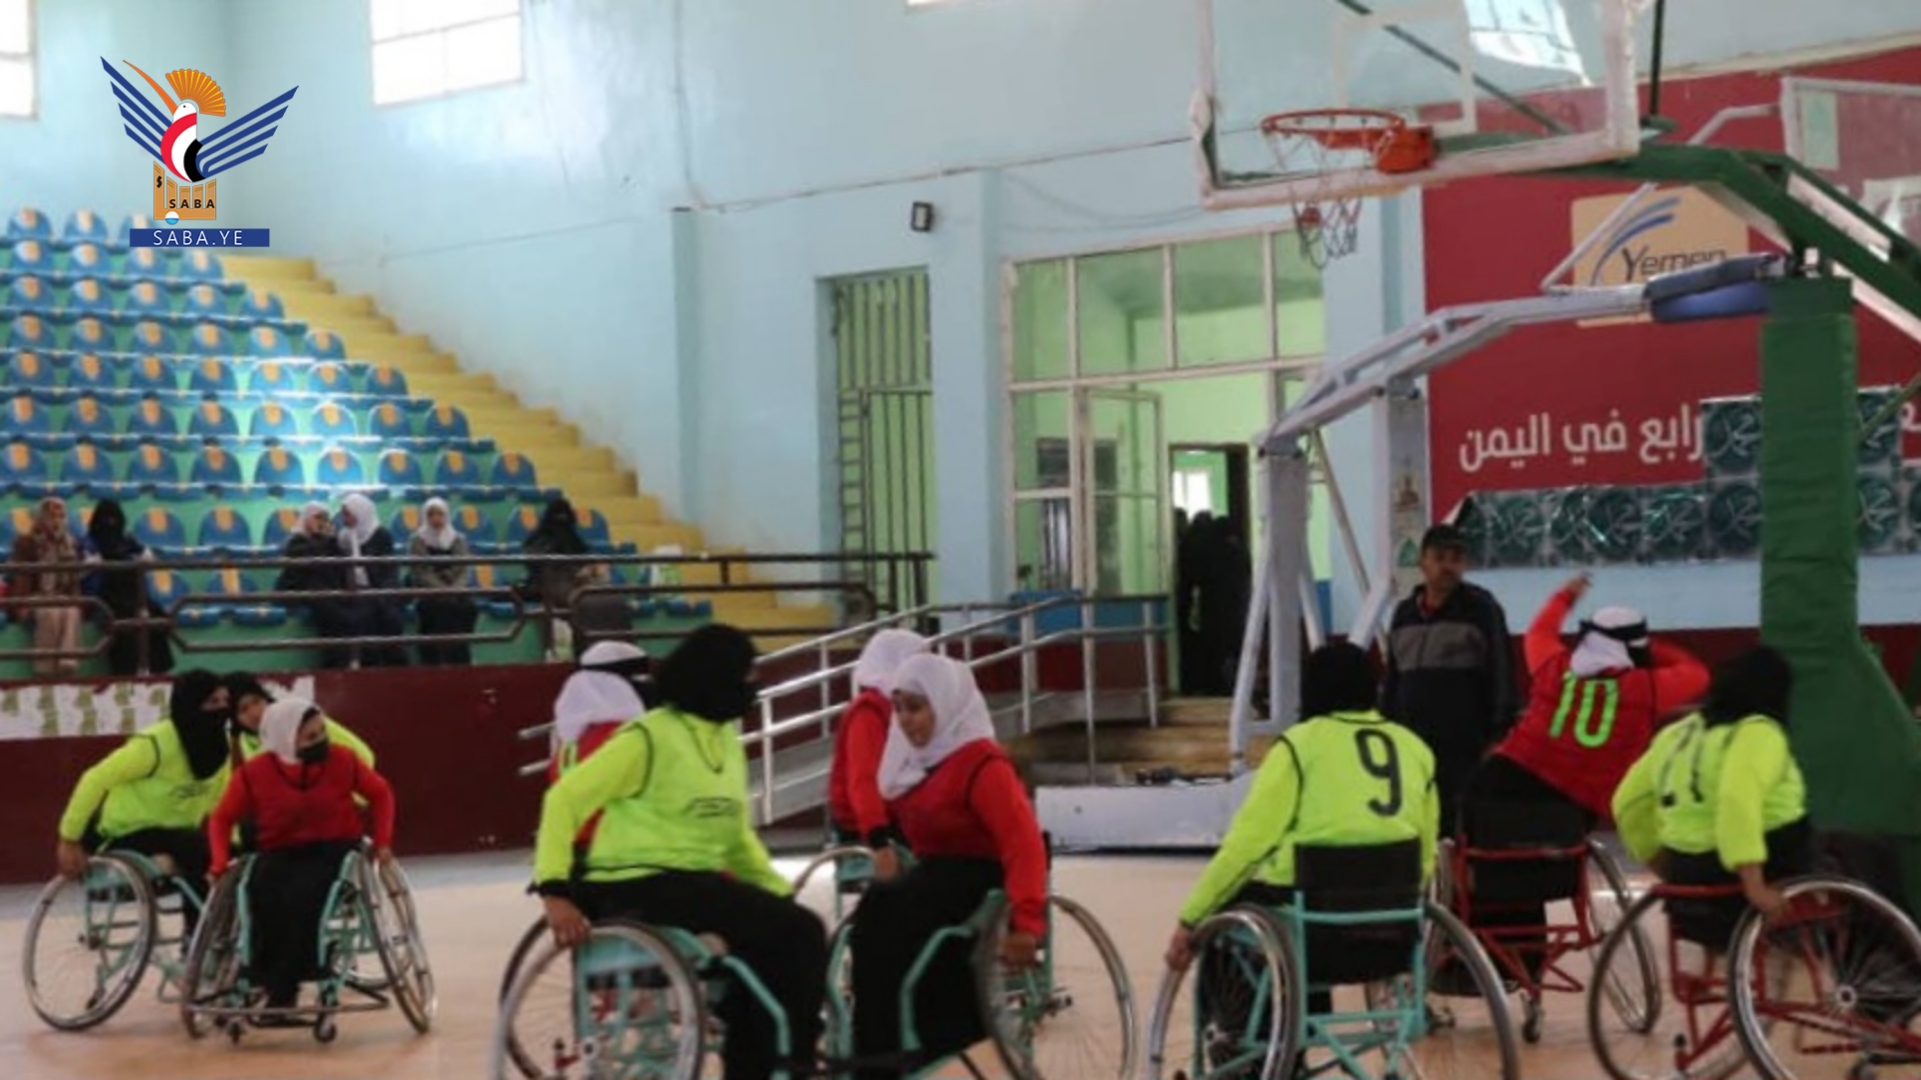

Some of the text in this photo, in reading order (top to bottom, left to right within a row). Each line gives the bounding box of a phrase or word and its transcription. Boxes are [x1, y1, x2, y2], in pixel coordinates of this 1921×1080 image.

[1458, 412, 1550, 473] اليمن
[1562, 408, 1628, 466] في
[1549, 671, 1619, 748] 10
[1354, 728, 1402, 817] 9
